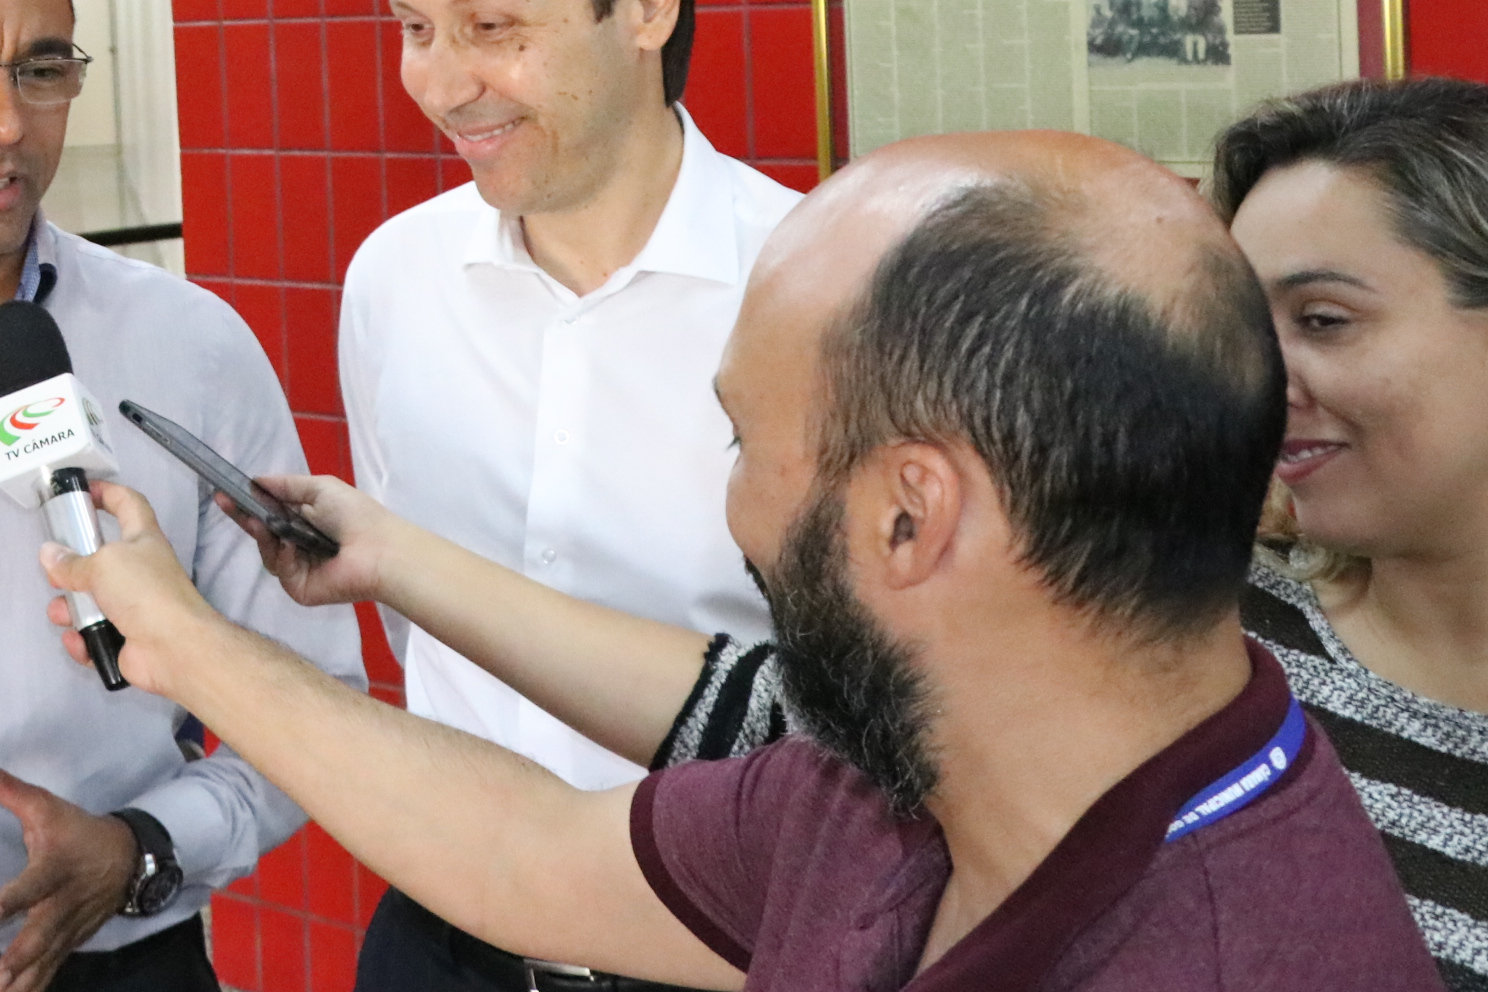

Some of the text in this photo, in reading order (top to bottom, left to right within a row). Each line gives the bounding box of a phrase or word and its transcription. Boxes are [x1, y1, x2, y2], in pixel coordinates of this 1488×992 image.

[5, 448, 21, 461] TV
[23, 428, 75, 454] CÂMARA
[1194, 782, 1245, 815] MUNICIPAL
